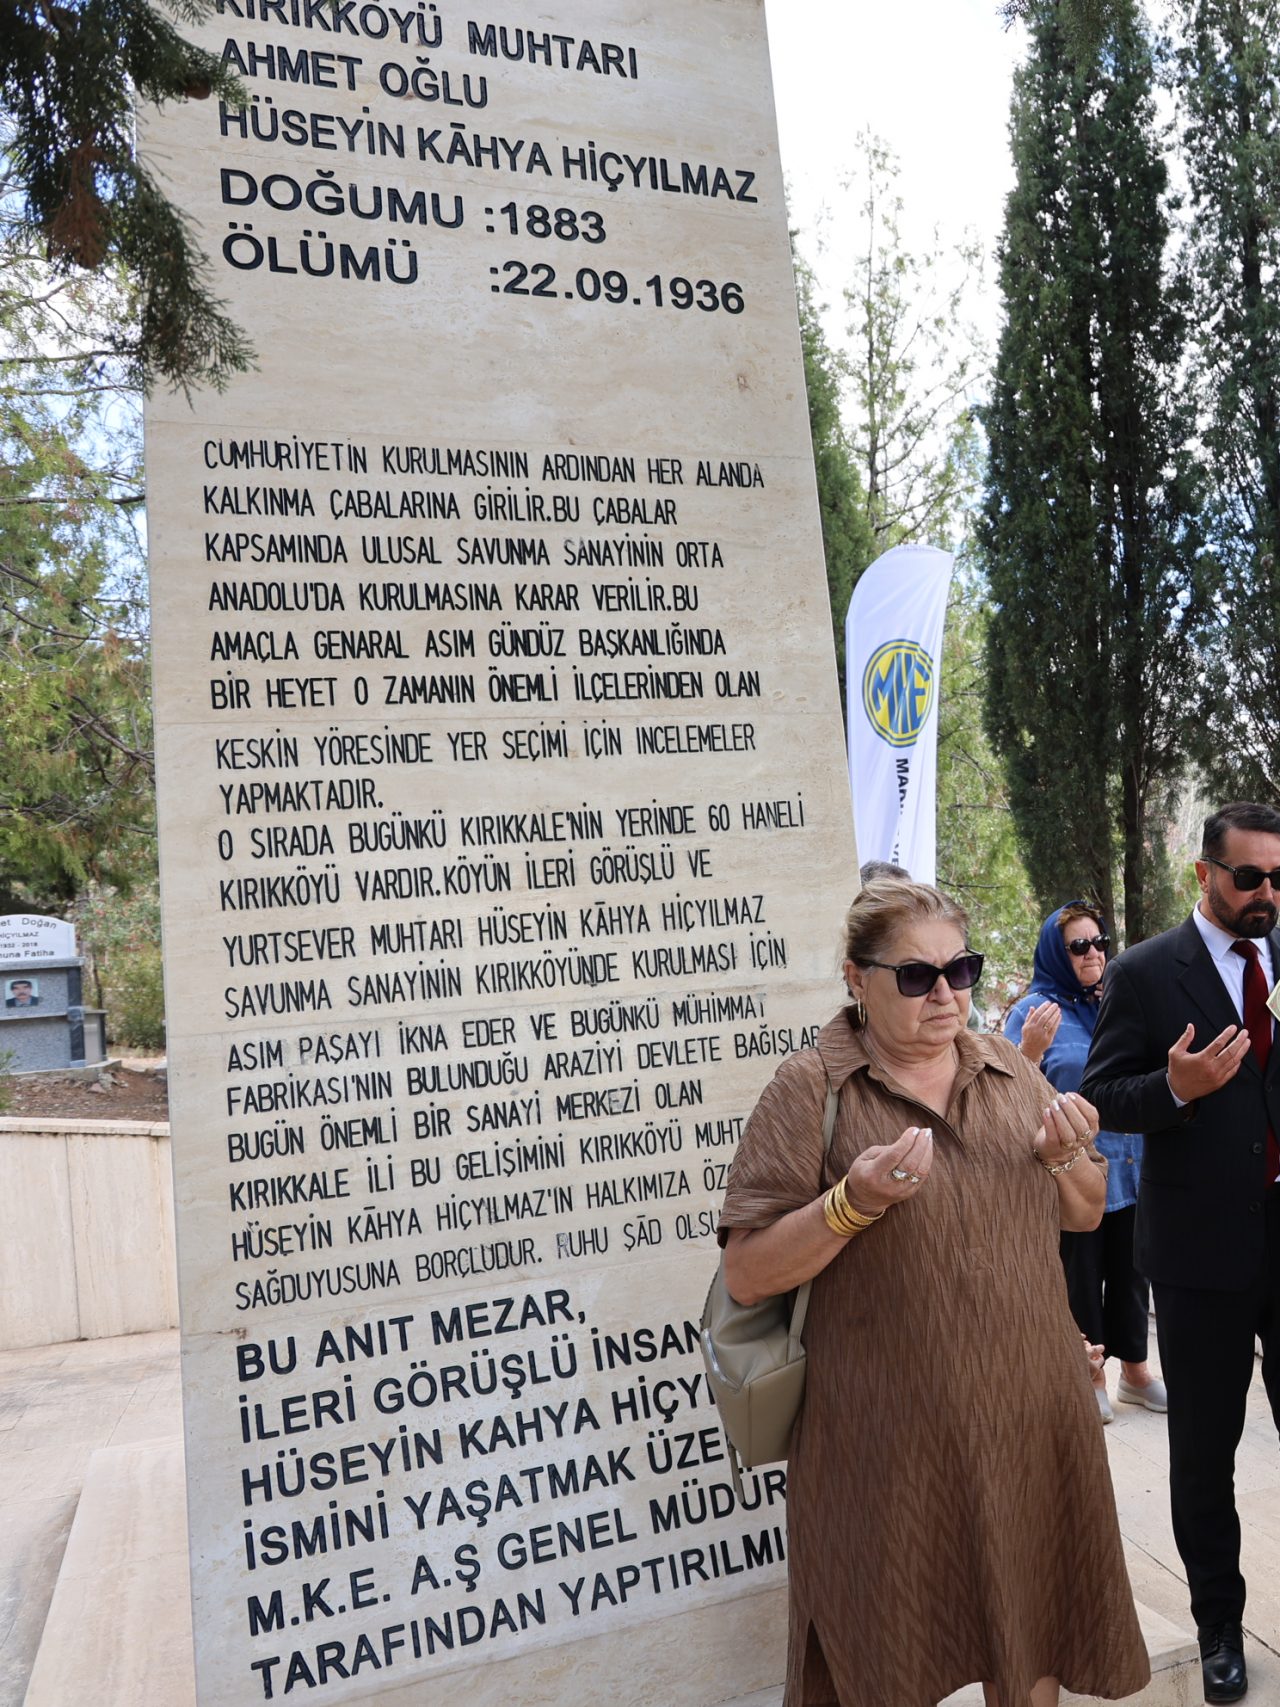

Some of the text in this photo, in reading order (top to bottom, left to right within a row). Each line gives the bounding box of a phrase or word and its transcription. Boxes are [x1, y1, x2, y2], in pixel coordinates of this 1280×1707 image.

[219, 38, 487, 108] AHMET OĞLU
[468, 21, 637, 79] MUHTARI
[218, 95, 405, 158] HÜSEYİN
[562, 141, 758, 203] HİÇYILMAZ
[220, 168, 606, 244] DOĞUMU :1883
[222, 222, 744, 314] ÖLÜMÜ :22.09.1936
[204, 485, 677, 526] KALKINMA ÇABALARINA GİRİLİR.BU ÇABALAR
[382, 446, 528, 478] KURULMASININ
[542, 454, 635, 483] ARDINDAN
[647, 458, 683, 485] HER
[696, 461, 764, 488] ALANDA
[205, 533, 724, 568] KAPSAMINDA ULUSAL SAVUNMA SANAYİNİN ORTA
[209, 577, 698, 612] ANADOLU'DA KURULMASINA KARAR VERİLİR.BU
[211, 621, 726, 663] AMAÇLA GENARAL ASIM GÜNDÜZ BAŞKANLIĞINDA
[211, 664, 760, 709] BİR HEYET O ZAMANIN ÖNEMLİ İLÇELERİNDEN OLAN
[216, 728, 298, 769] KESKİN
[314, 725, 433, 766] YÖRESİNDE
[447, 731, 488, 761] YER
[503, 720, 568, 762] SEÇİMİ
[584, 719, 622, 759] İÇİN
[218, 792, 804, 861] O SIRADA BUGÜNKÜ KIRIKKALE'NİN YERİNDE 60 HANELİ
[219, 778, 384, 816] YAPMAKTADIR.
[220, 864, 339, 911] KIRIKKÖYÜ
[525, 849, 575, 889] İLERİ
[590, 843, 674, 885] GÖRÜŞLÜ
[688, 849, 712, 877] VE
[21, 917, 57, 929] Doğan
[223, 927, 356, 967] YURTSEVER
[371, 919, 462, 955] MUHTARI
[478, 903, 567, 946] HÜSEYİN
[662, 893, 765, 932] HİÇYILMAZ
[225, 931, 786, 1018] SAVUNMA SANAYİNİN KIRIKKÖYÜNDE KURULMASI İÇİN
[228, 992, 767, 1072] ASIM PAŞAYI İKNA EDER VE BUGÜNKÜ MÜHİMMAT
[227, 1071, 392, 1116] FABRİKASI'NIN
[407, 1051, 528, 1096] BULUNDUĞU
[544, 1039, 622, 1080] ARAZİYİ
[637, 1036, 722, 1069] DEVLETE
[228, 1079, 702, 1163] BUGÜN ÖNEMLİ BİR SANAYİ MERKEZİ OLAN
[230, 1168, 350, 1212] KIRIKKALE
[367, 1155, 394, 1193] İLİ
[411, 1157, 440, 1187] BU
[456, 1133, 565, 1180] GELİŞİMİNİ
[580, 1119, 682, 1164] KIRIKKÖYÜ
[232, 1213, 332, 1261] HÜSEYİN
[586, 1170, 691, 1209] HALKIMIZA
[704, 1159, 731, 1196] ÖZ
[236, 1259, 400, 1310] SAĞDUYUSUNA
[415, 1238, 542, 1282] BORÇLUDUR.
[556, 1227, 608, 1259] RUHU
[236, 1289, 585, 1382] BU ANIT MEZAR,
[239, 1374, 356, 1443] İLERİ
[374, 1333, 577, 1414] GÖRÜŞLÜ
[242, 1425, 443, 1506] HÜSEYİN
[459, 1398, 600, 1459] KAHYA
[244, 1490, 389, 1570] İSMİNİ
[403, 1447, 636, 1530] YAŞATMAK
[247, 1568, 390, 1636] M.K.E.
[411, 1544, 480, 1595] A.Ş
[498, 1508, 637, 1570] GENEL
[251, 1588, 546, 1700] TARAFINDAN
